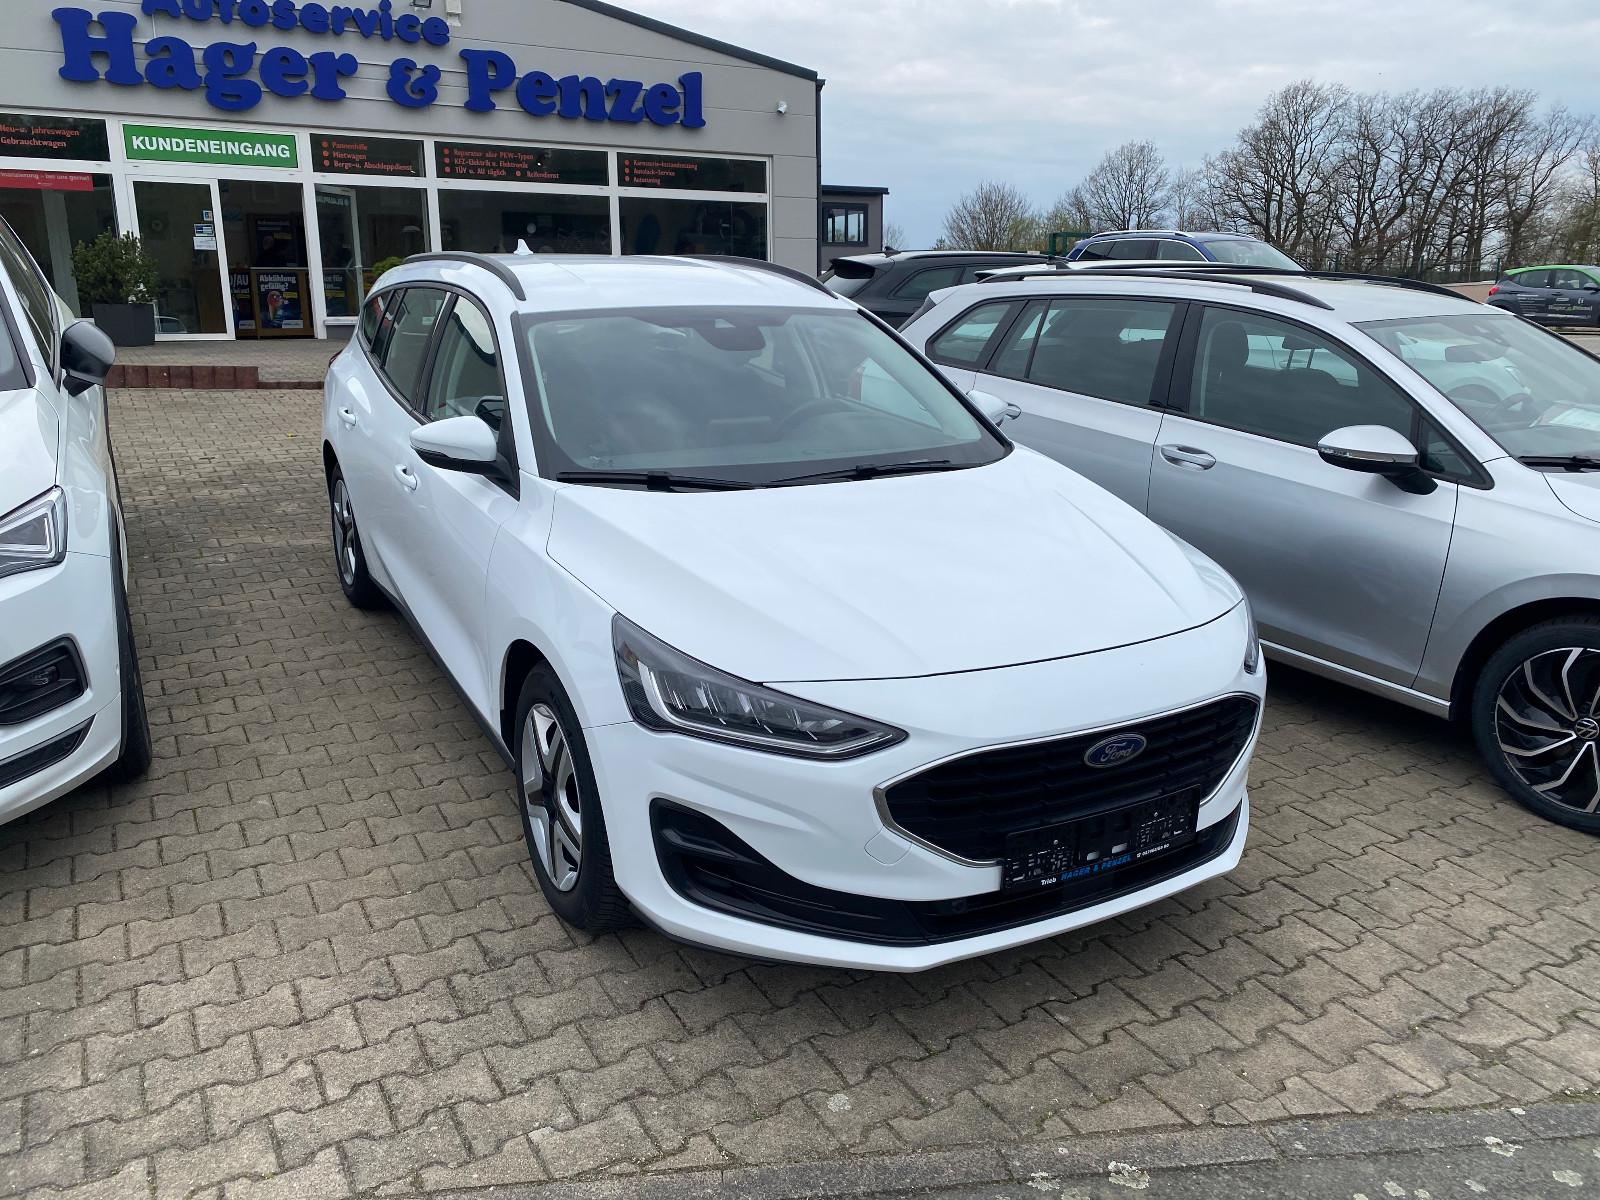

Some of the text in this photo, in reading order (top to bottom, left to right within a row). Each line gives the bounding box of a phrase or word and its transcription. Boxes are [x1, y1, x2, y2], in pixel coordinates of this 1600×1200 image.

[53, 8, 704, 127] Hager & Penzel
[1, 136, 66, 148] Gebrauchtwagen
[132, 135, 290, 159] KUNDENEINGANG
[333, 151, 366, 161] Mietwagen
[364, 162, 412, 171] Abschleppdienst
[1100, 741, 1134, 762] Ford
